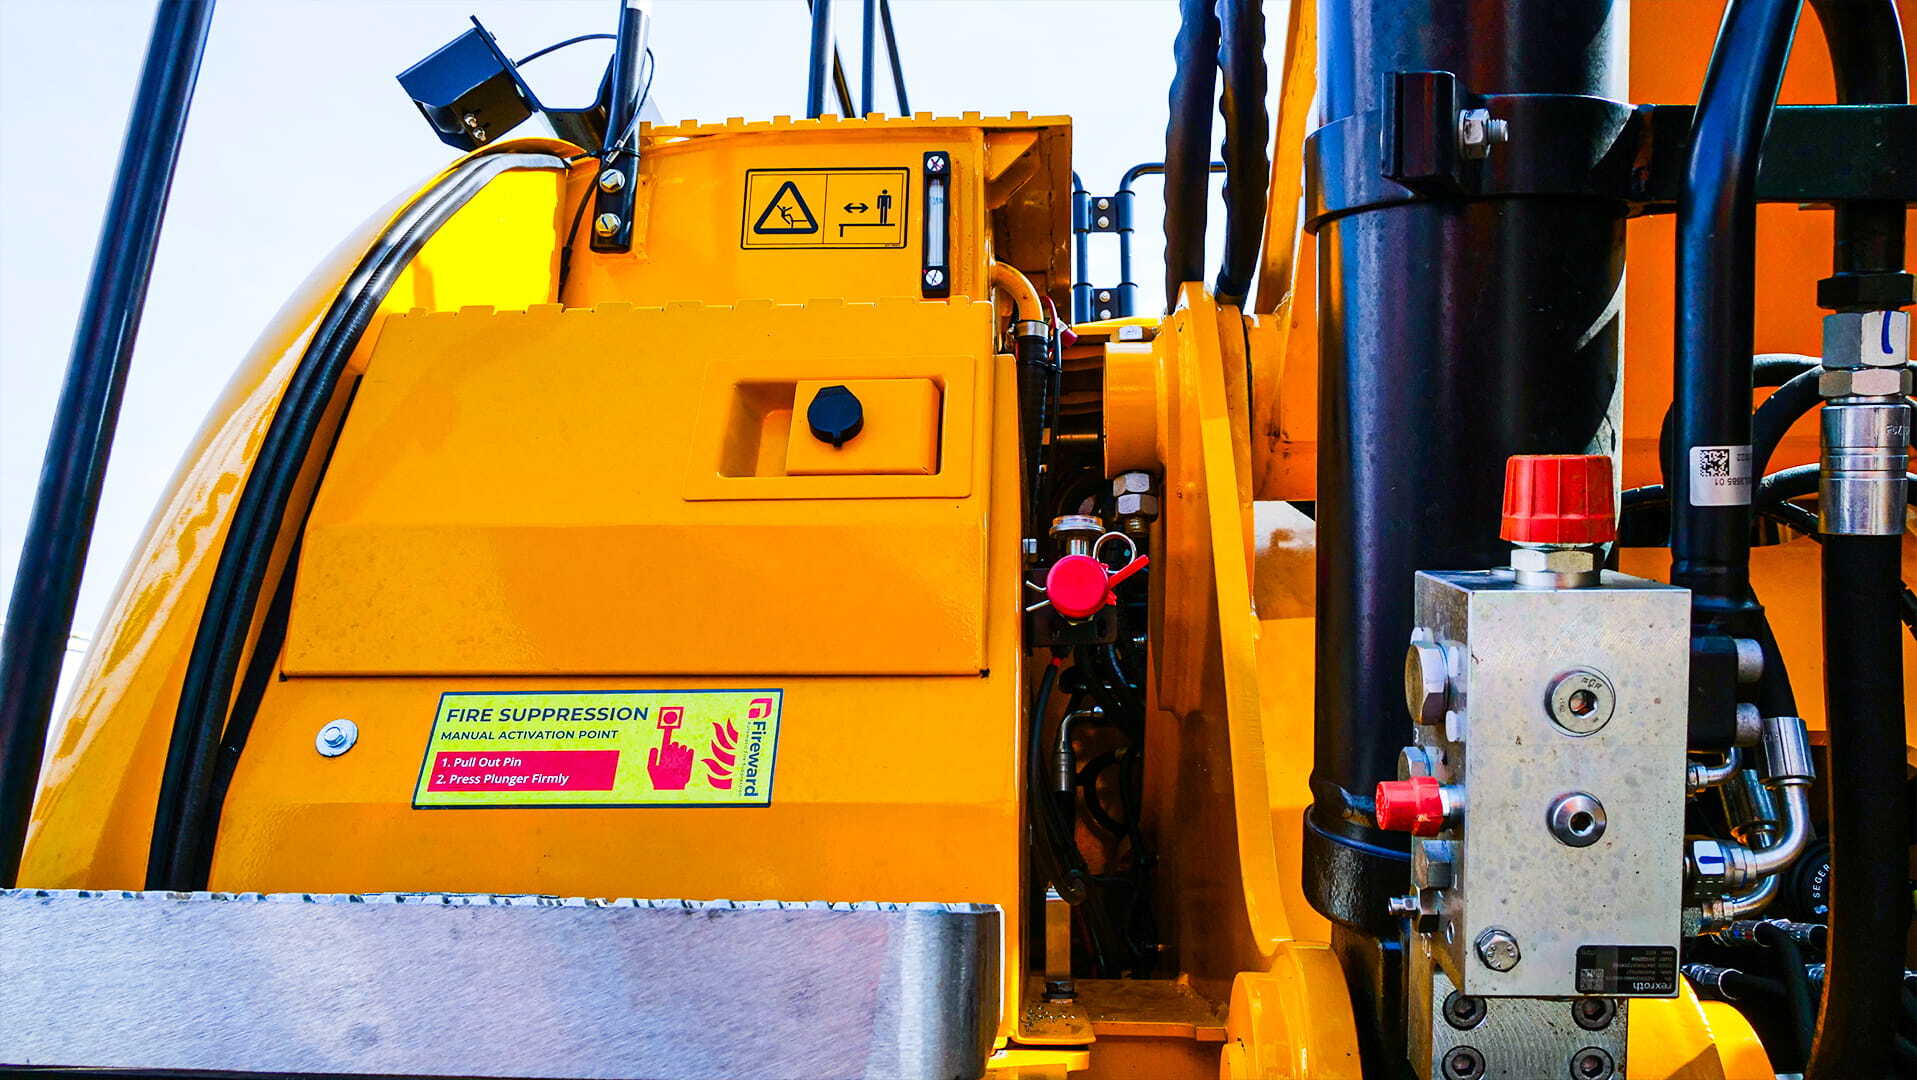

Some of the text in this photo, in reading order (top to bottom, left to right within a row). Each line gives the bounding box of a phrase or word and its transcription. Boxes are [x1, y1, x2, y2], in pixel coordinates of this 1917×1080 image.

[446, 706, 649, 722] FIRE SUPPRESSION
[441, 729, 619, 740] MANUAL ACTIVATION POINT
[441, 756, 522, 768] 1. Pull Out Pin
[744, 721, 767, 797] Fireward
[435, 772, 570, 787] 2. Press Plunger Firmly
[1632, 982, 1673, 992] rexroth
